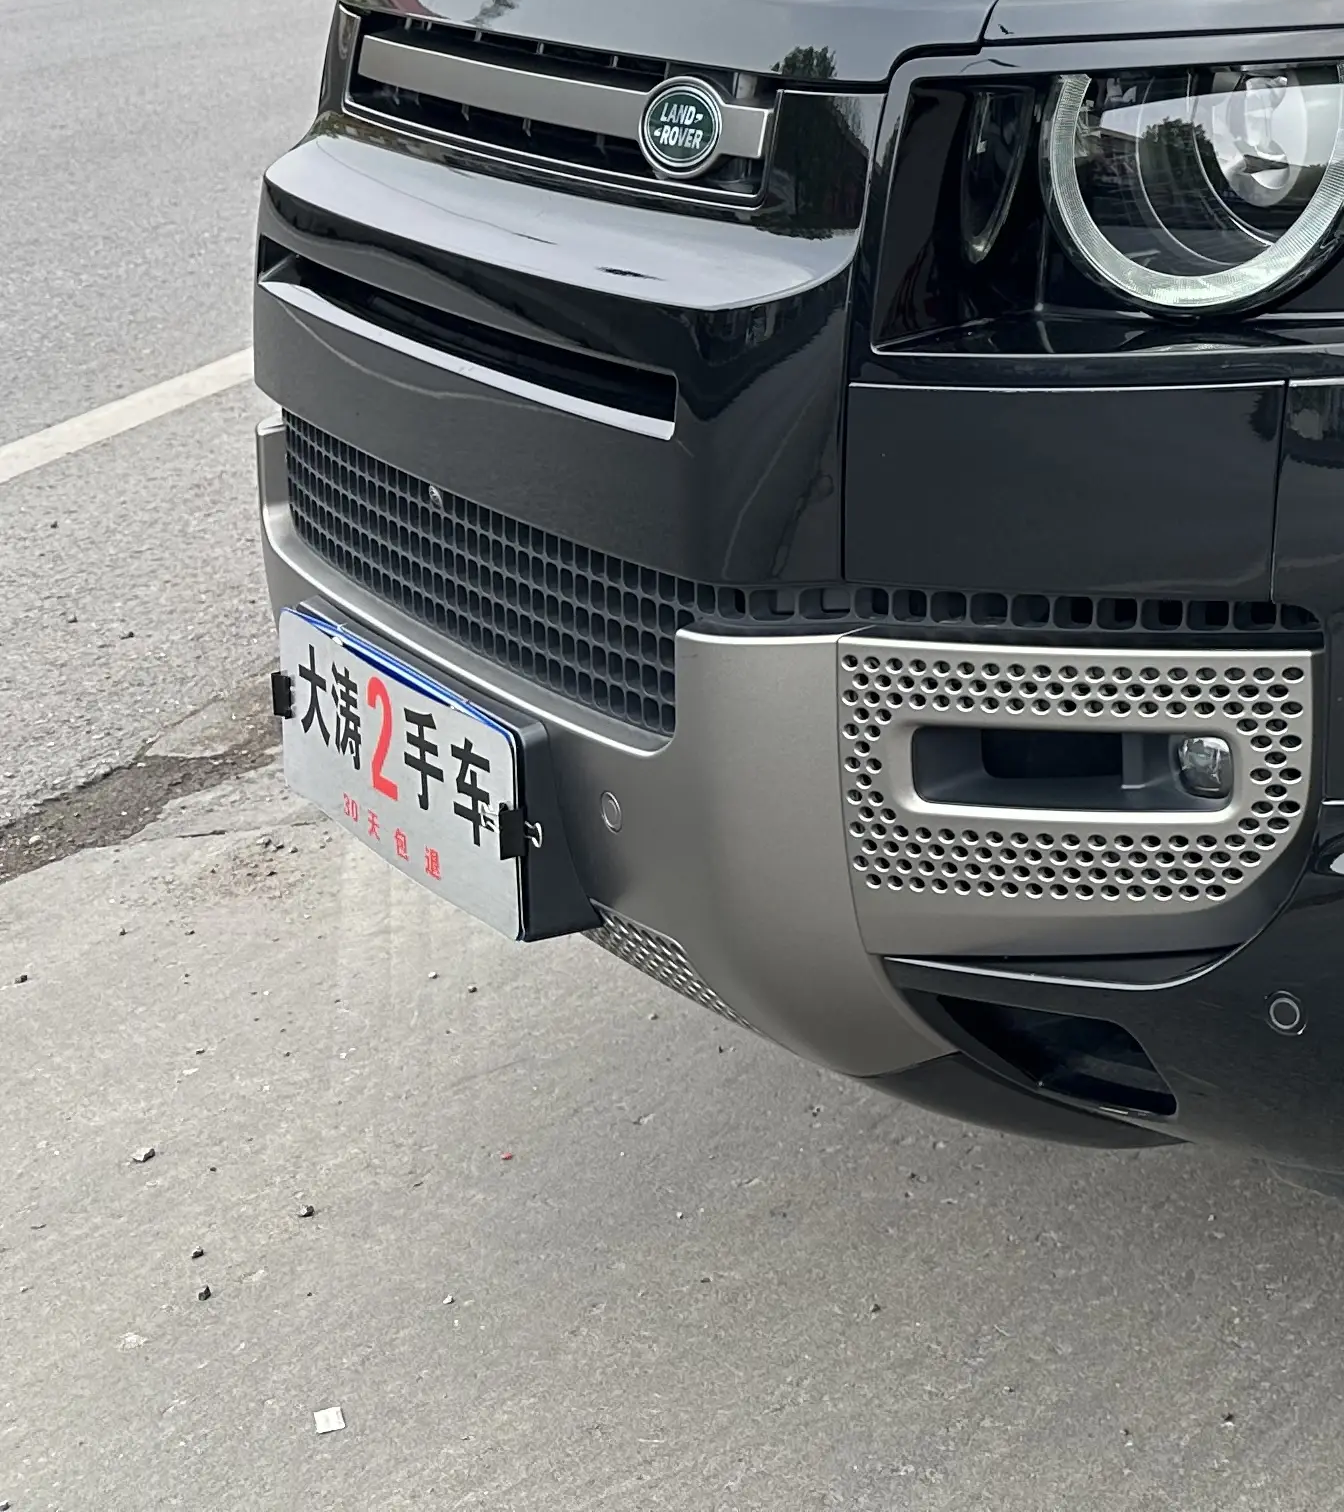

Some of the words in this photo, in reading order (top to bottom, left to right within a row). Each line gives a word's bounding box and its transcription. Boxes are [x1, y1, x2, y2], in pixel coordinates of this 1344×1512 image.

[660, 101, 697, 126] LAND
[660, 124, 704, 150] ROVER
[298, 644, 492, 847] 大涛2手车
